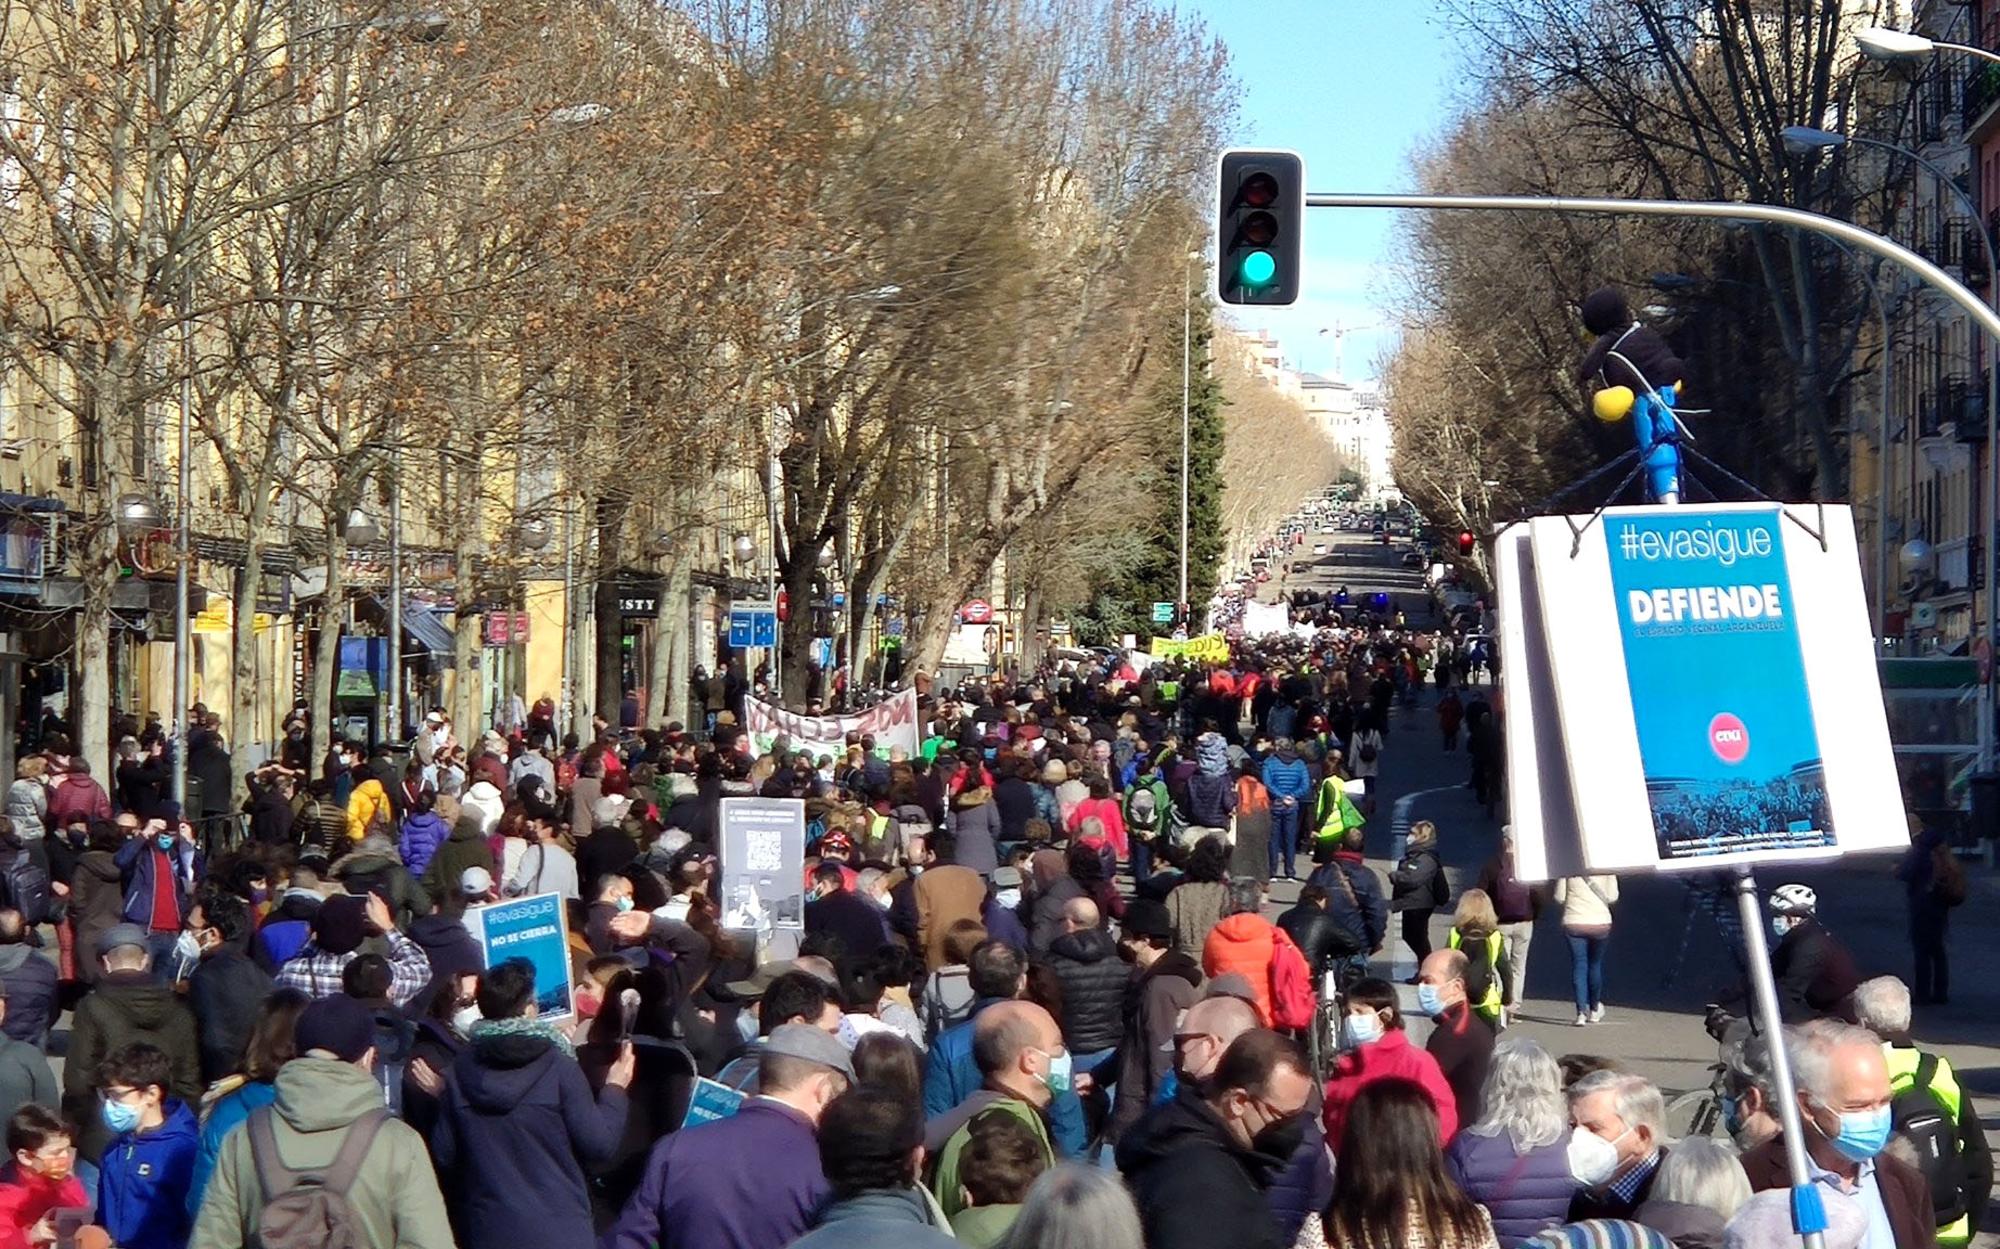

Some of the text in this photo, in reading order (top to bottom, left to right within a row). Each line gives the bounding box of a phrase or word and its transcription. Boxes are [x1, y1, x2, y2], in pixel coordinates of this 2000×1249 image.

[1620, 520, 1772, 565] #evasigue
[1628, 584, 1783, 623] DEFIENDE
[488, 901, 554, 924] #evasigue
[491, 936, 506, 947] NO
